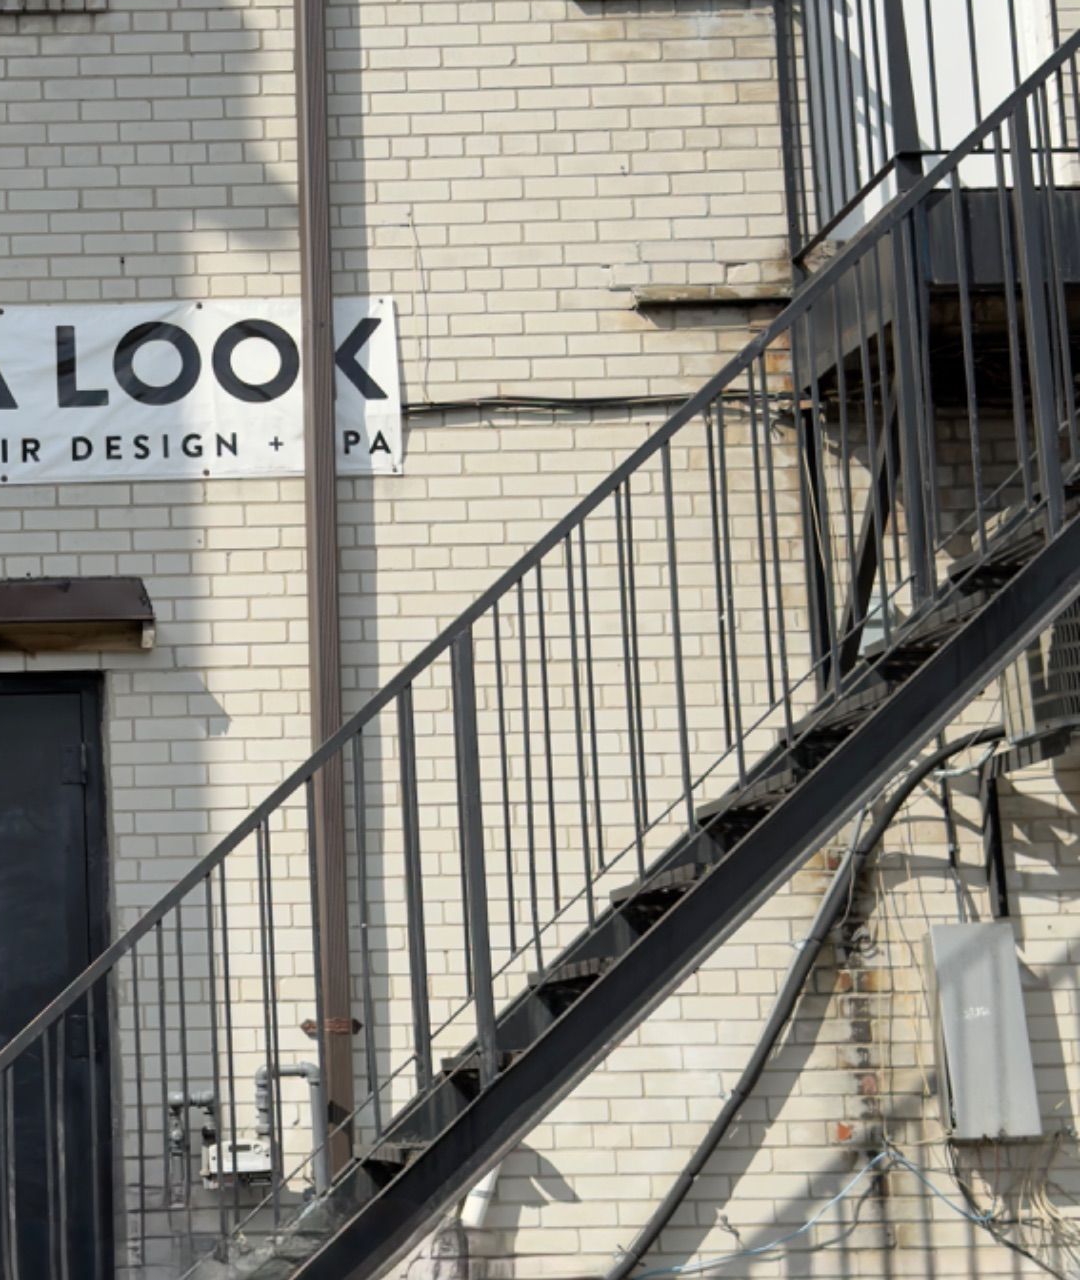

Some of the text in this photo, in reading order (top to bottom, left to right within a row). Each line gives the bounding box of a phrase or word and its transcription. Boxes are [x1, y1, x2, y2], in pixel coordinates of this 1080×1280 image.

[56, 317, 388, 407] LOOK
[71, 433, 237, 462] DESIGN
[342, 430, 392, 455] PA
